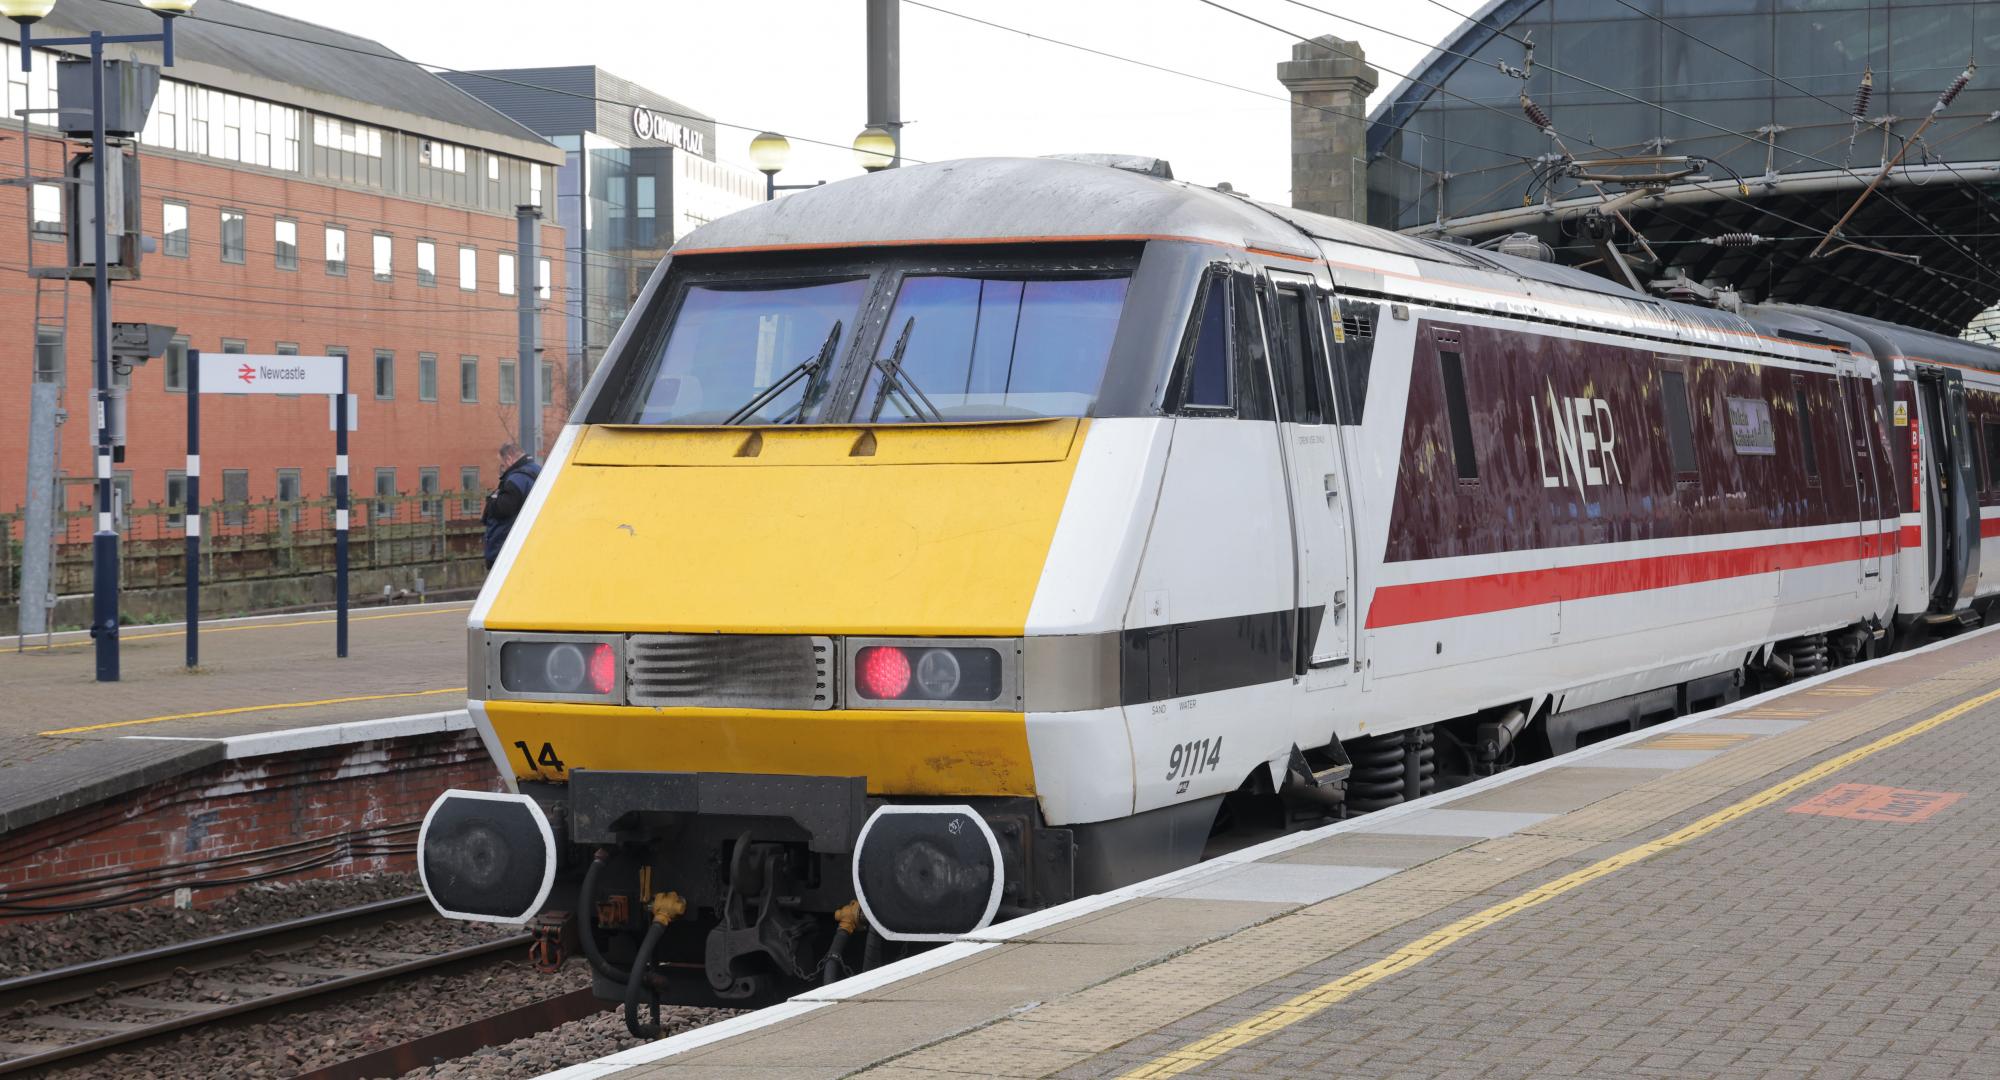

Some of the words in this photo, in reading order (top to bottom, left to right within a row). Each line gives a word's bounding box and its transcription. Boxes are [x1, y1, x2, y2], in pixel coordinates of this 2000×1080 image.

[259, 366, 306, 380] Newcastle
[1530, 375, 1623, 504] LNER
[1912, 431, 1917, 445] B
[1151, 704, 1167, 715] SAND
[1179, 699, 1197, 711] WATER
[514, 740, 565, 772] 14
[1166, 735, 1223, 781] 91114
